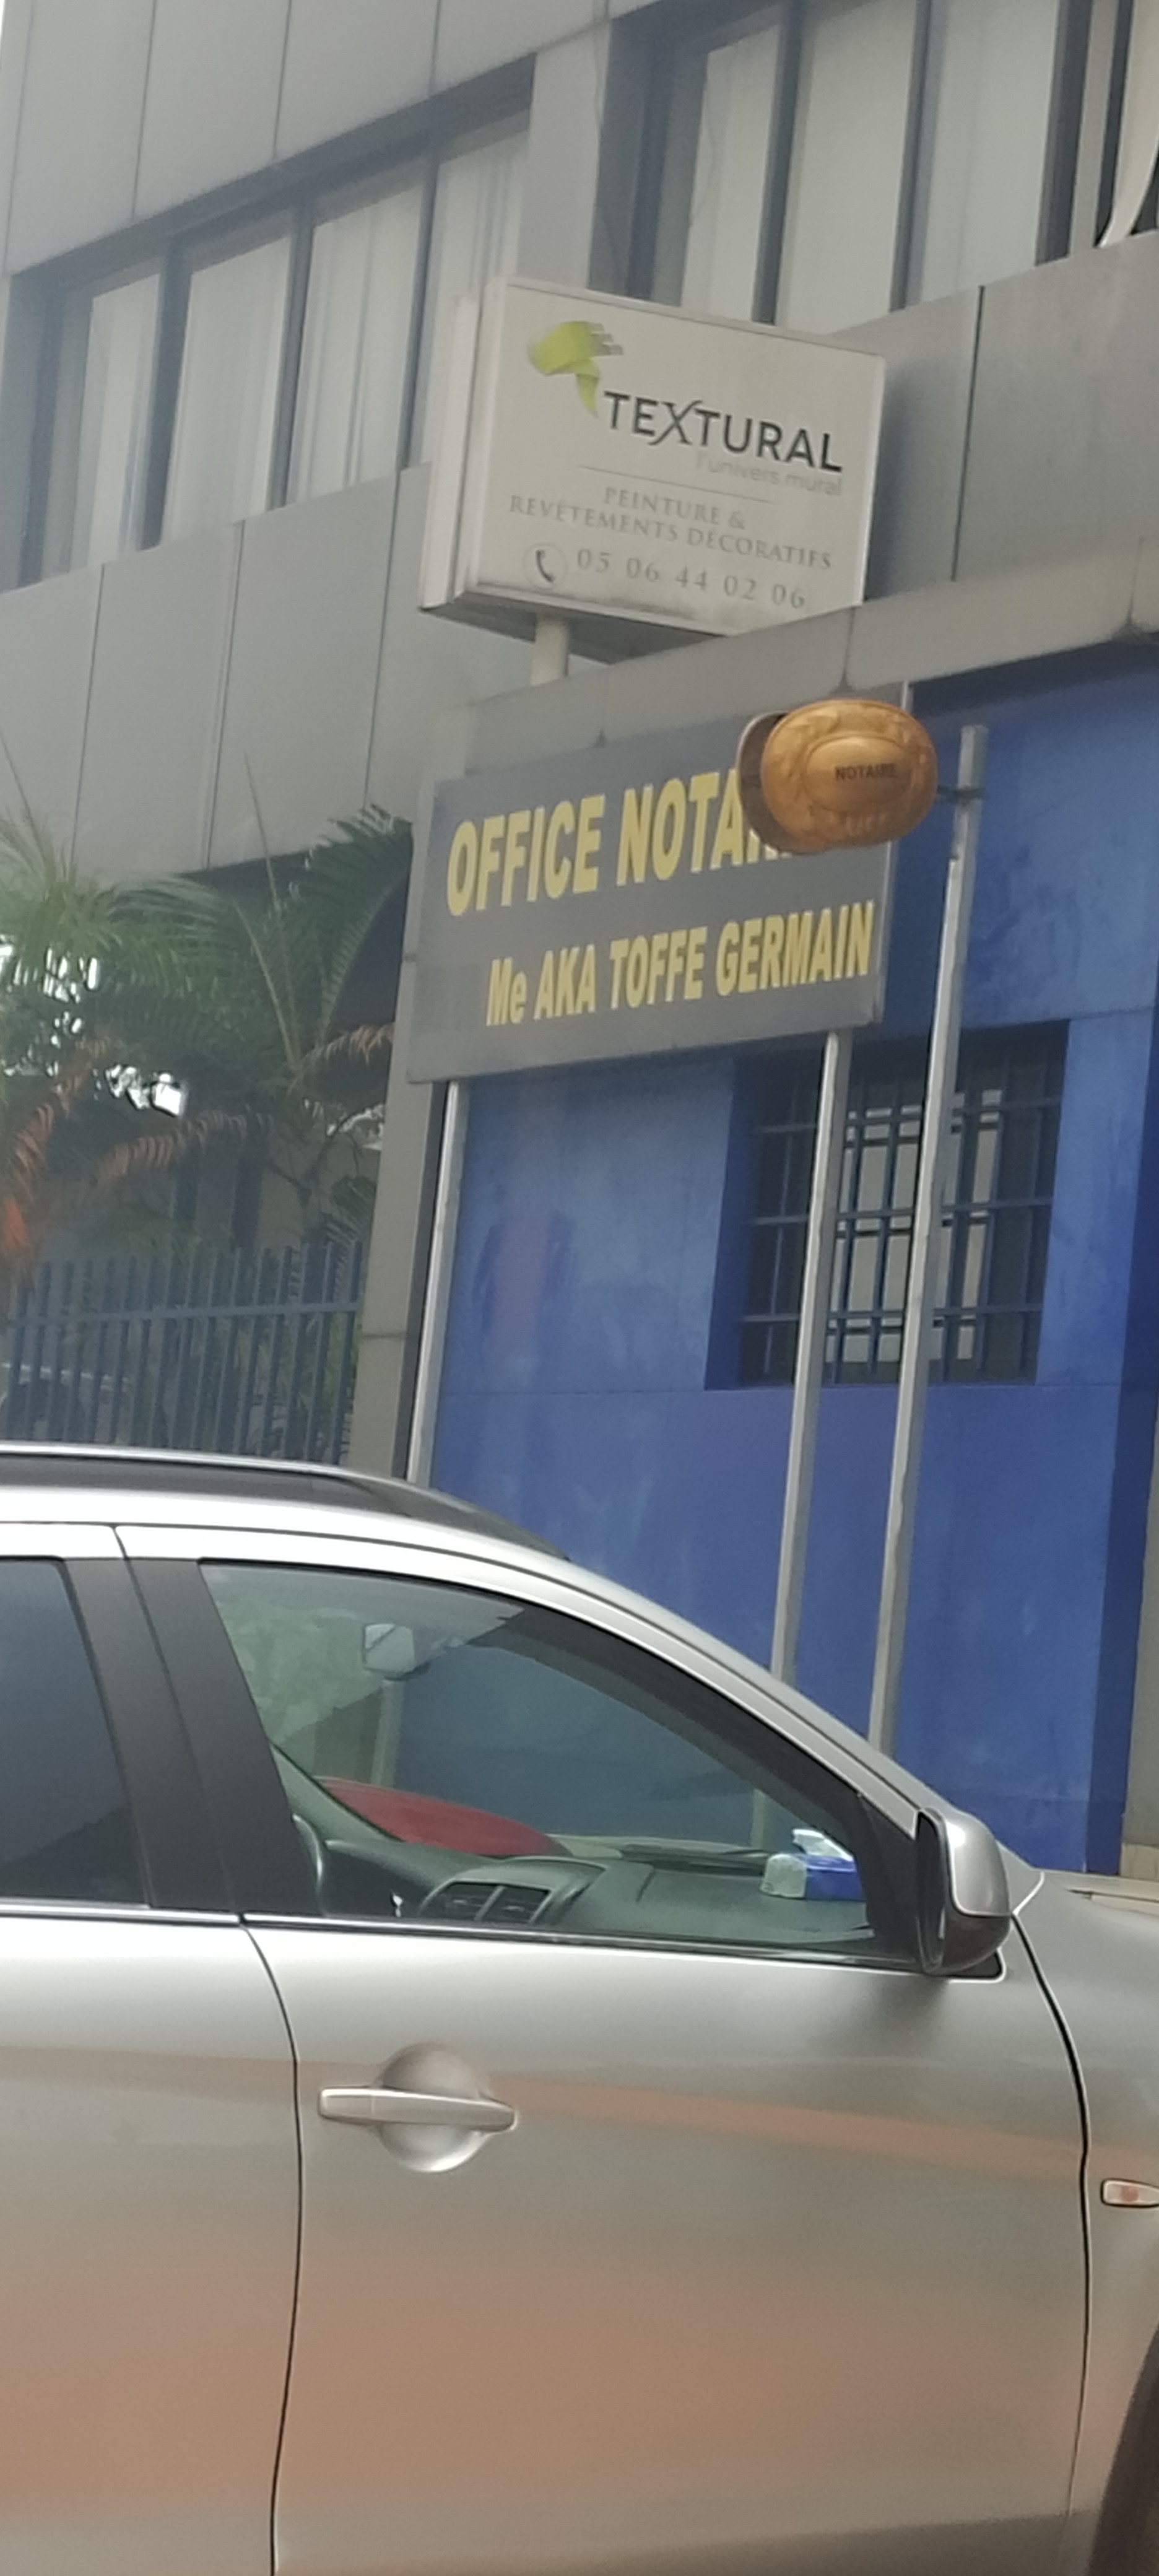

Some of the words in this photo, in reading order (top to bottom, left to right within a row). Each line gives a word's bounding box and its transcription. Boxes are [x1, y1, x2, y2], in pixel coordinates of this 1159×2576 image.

[604, 390, 843, 472] TEXTURAL
[603, 487, 721, 525] PEINTURE
[727, 510, 746, 529] &
[784, 472, 843, 497] mural
[576, 548, 610, 574] 05
[626, 557, 660, 584] 06
[675, 565, 708, 592] 44
[724, 568, 757, 601] 02
[771, 583, 805, 609] 06
[446, 794, 605, 916] OFFICE
[486, 957, 527, 1027] Me
[534, 944, 596, 1020] AKA
[610, 926, 708, 1011] TOFFE
[716, 900, 874, 997] GERMAIN
